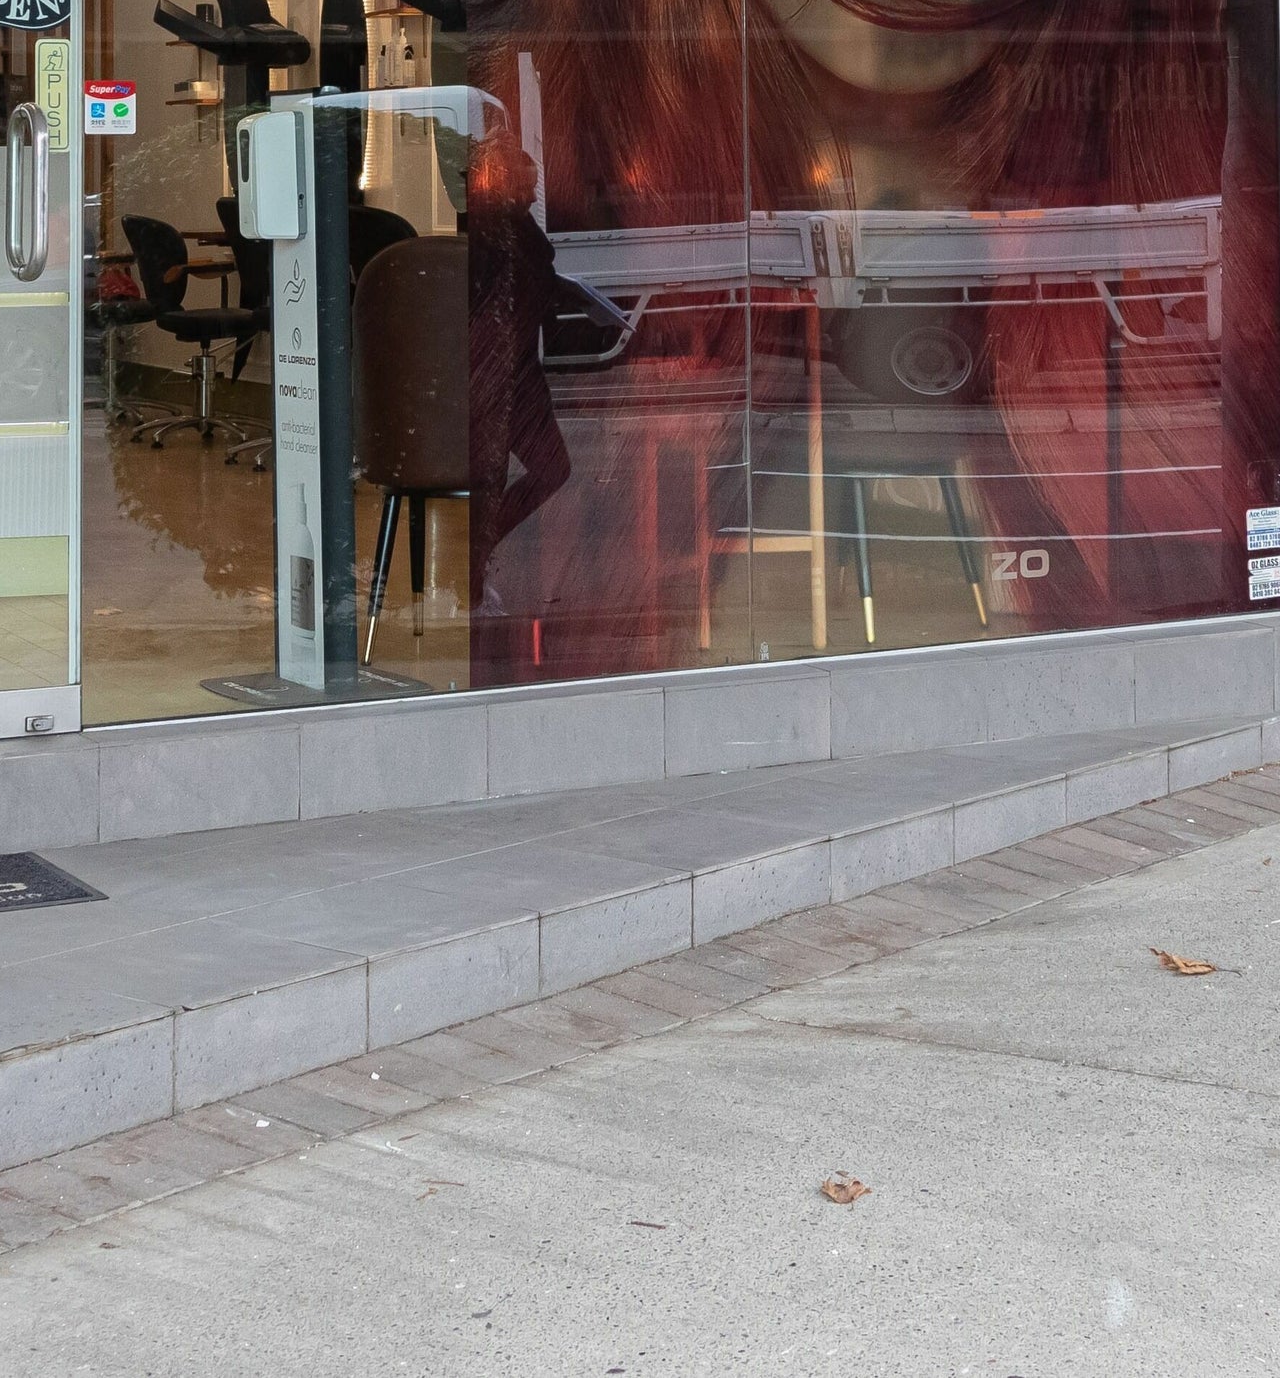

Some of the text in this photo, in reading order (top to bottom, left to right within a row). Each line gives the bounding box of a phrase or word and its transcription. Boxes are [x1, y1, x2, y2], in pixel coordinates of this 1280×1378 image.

[47, 73, 62, 145] PUSH
[279, 354, 316, 366] DE LORENZO
[279, 378, 317, 401] novaclean
[280, 436, 317, 455] hand cleanser
[991, 548, 1050, 581] ZO
[1259, 558, 1279, 568] GLASS
